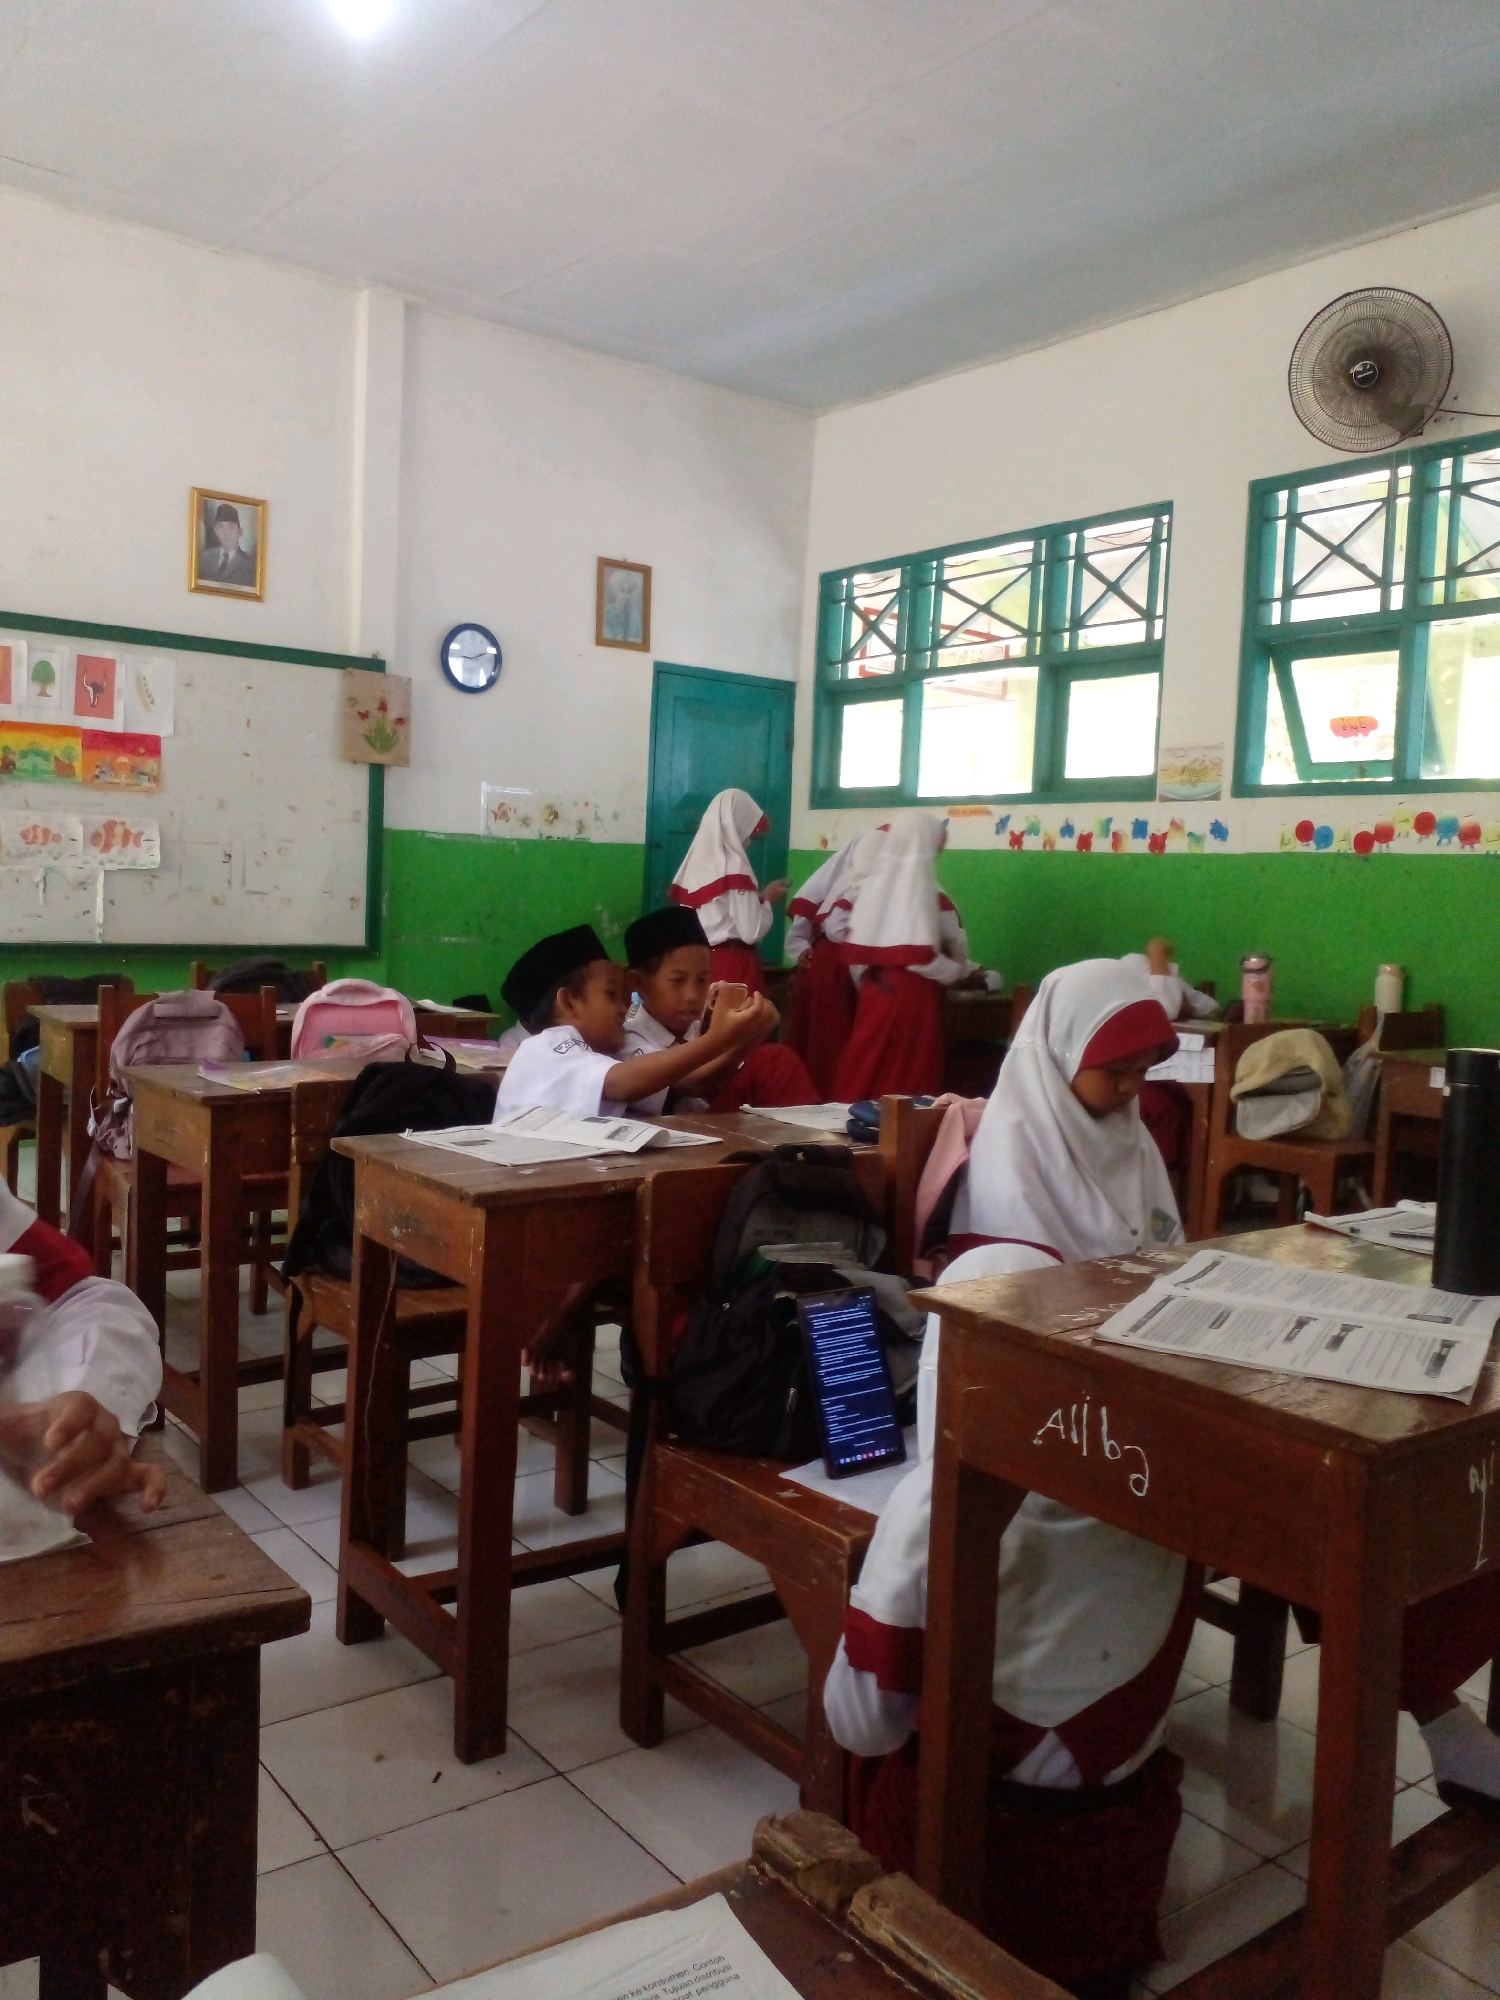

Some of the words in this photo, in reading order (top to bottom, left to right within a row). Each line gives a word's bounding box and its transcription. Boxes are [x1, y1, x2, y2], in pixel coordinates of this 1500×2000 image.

[629, 1988, 643, 1997] ke
[692, 1955, 726, 1971] Contoh
[662, 1979, 694, 1995] Tujuan
[693, 1962, 733, 1983] distribusi
[695, 1973, 740, 1996] pengguna
